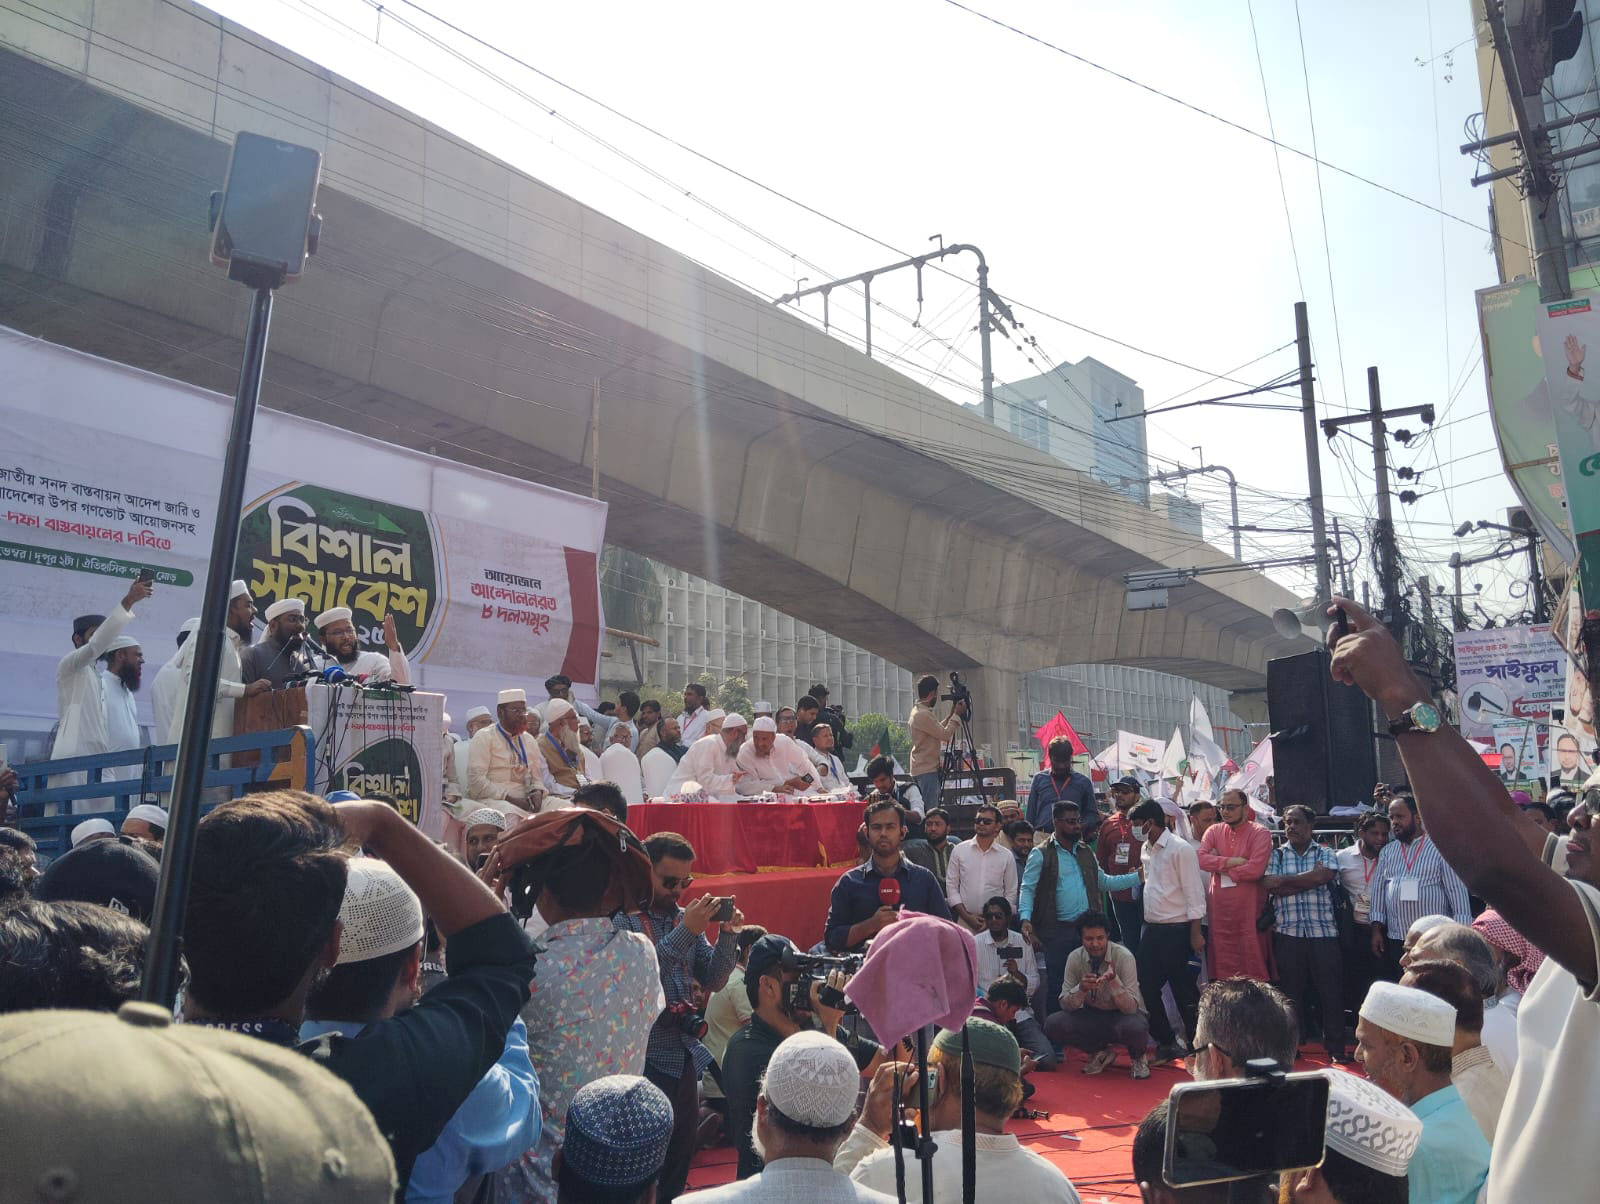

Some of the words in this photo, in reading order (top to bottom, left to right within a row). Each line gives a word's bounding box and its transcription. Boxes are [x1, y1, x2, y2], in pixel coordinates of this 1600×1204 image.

[39, 476, 68, 493] সনদ
[71, 483, 121, 502] বাস্তবায়ন
[124, 494, 161, 511] আদেশ
[165, 502, 188, 517] জারি
[192, 509, 200, 518] ও
[48, 493, 78, 512] উপর
[81, 503, 126, 521] গণভোট
[129, 512, 196, 535] আয়োজনসহ
[44, 518, 123, 543] বাস্তবায়নের
[127, 530, 171, 550] দাবিতে
[268, 495, 412, 582] বিশাল
[35, 552, 57, 566] দুপুর
[81, 556, 128, 574] ঐতিহাসিক
[484, 569, 541, 590] আয়োজনে
[251, 558, 428, 628] সমাবেশ
[470, 582, 557, 611] আন্দোলনরত
[481, 603, 493, 619] ৮
[497, 606, 550, 636] দলসমূহ
[1484, 659, 1558, 686] সাইফুল
[343, 762, 410, 797] বিশাল
